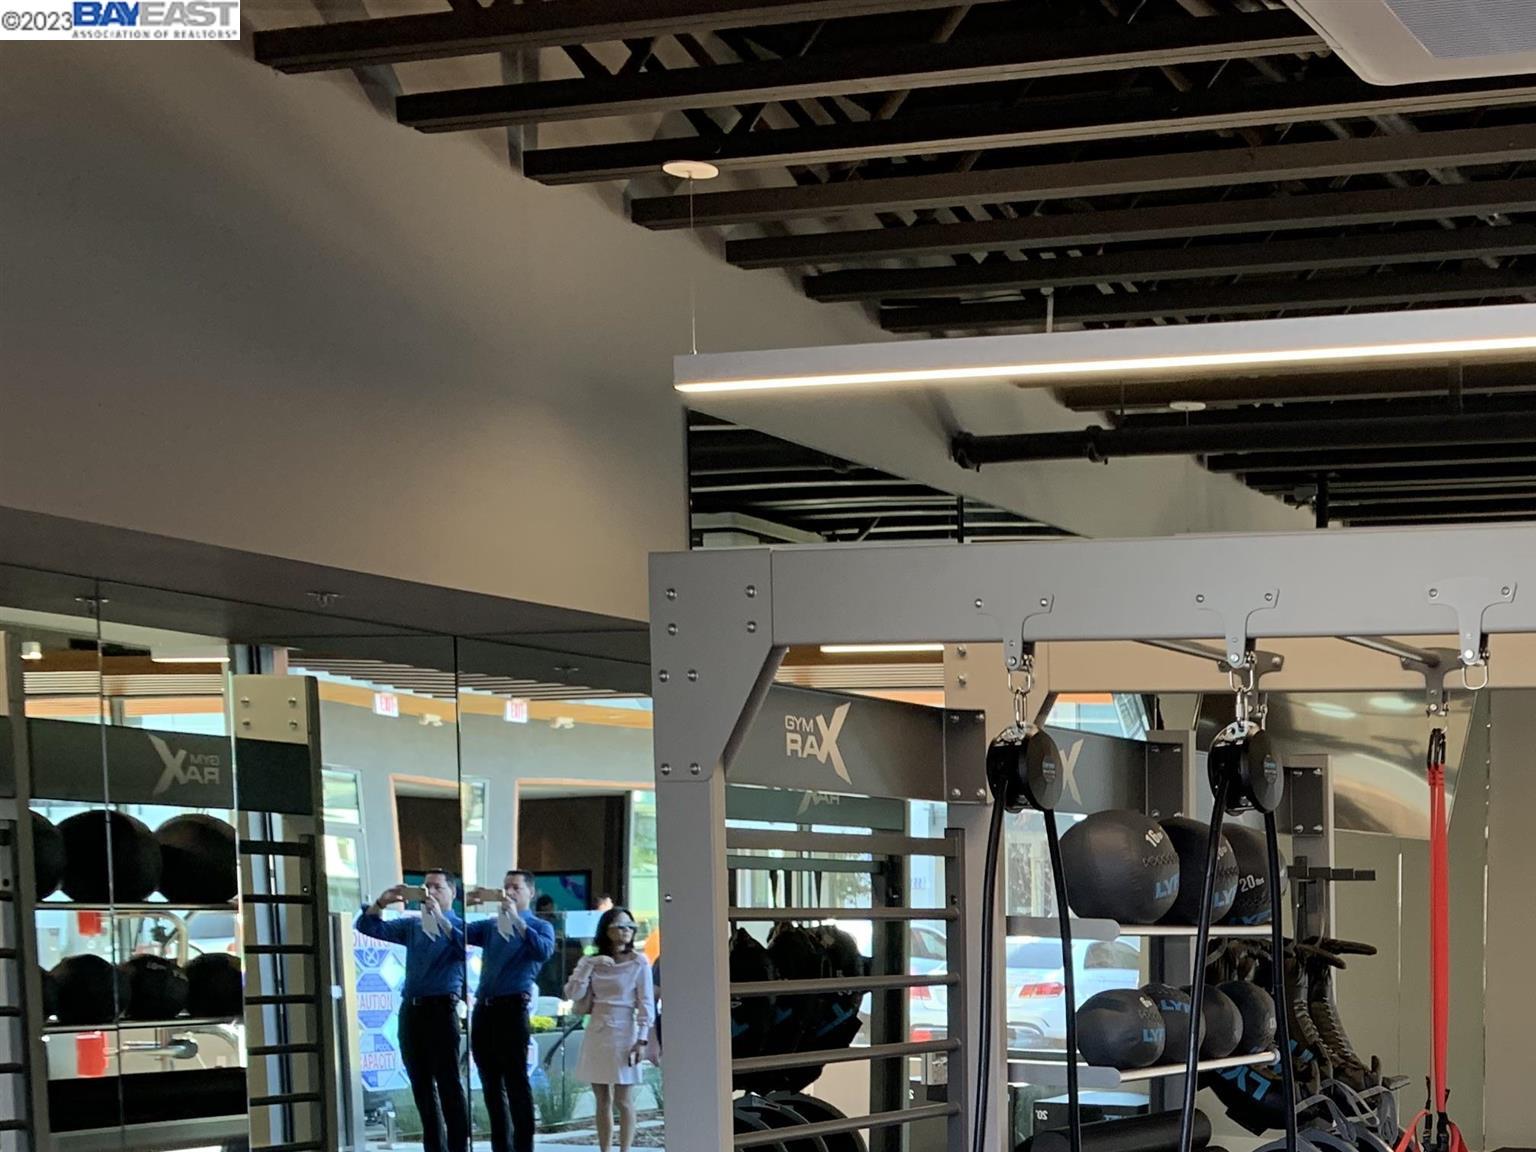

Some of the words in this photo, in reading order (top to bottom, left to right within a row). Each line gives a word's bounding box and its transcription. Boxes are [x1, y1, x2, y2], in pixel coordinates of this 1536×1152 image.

[784, 714, 814, 733] GYM
[785, 701, 852, 785] RAX
[358, 993, 393, 1010] AUTION
[361, 1052, 397, 1071] APACITY
